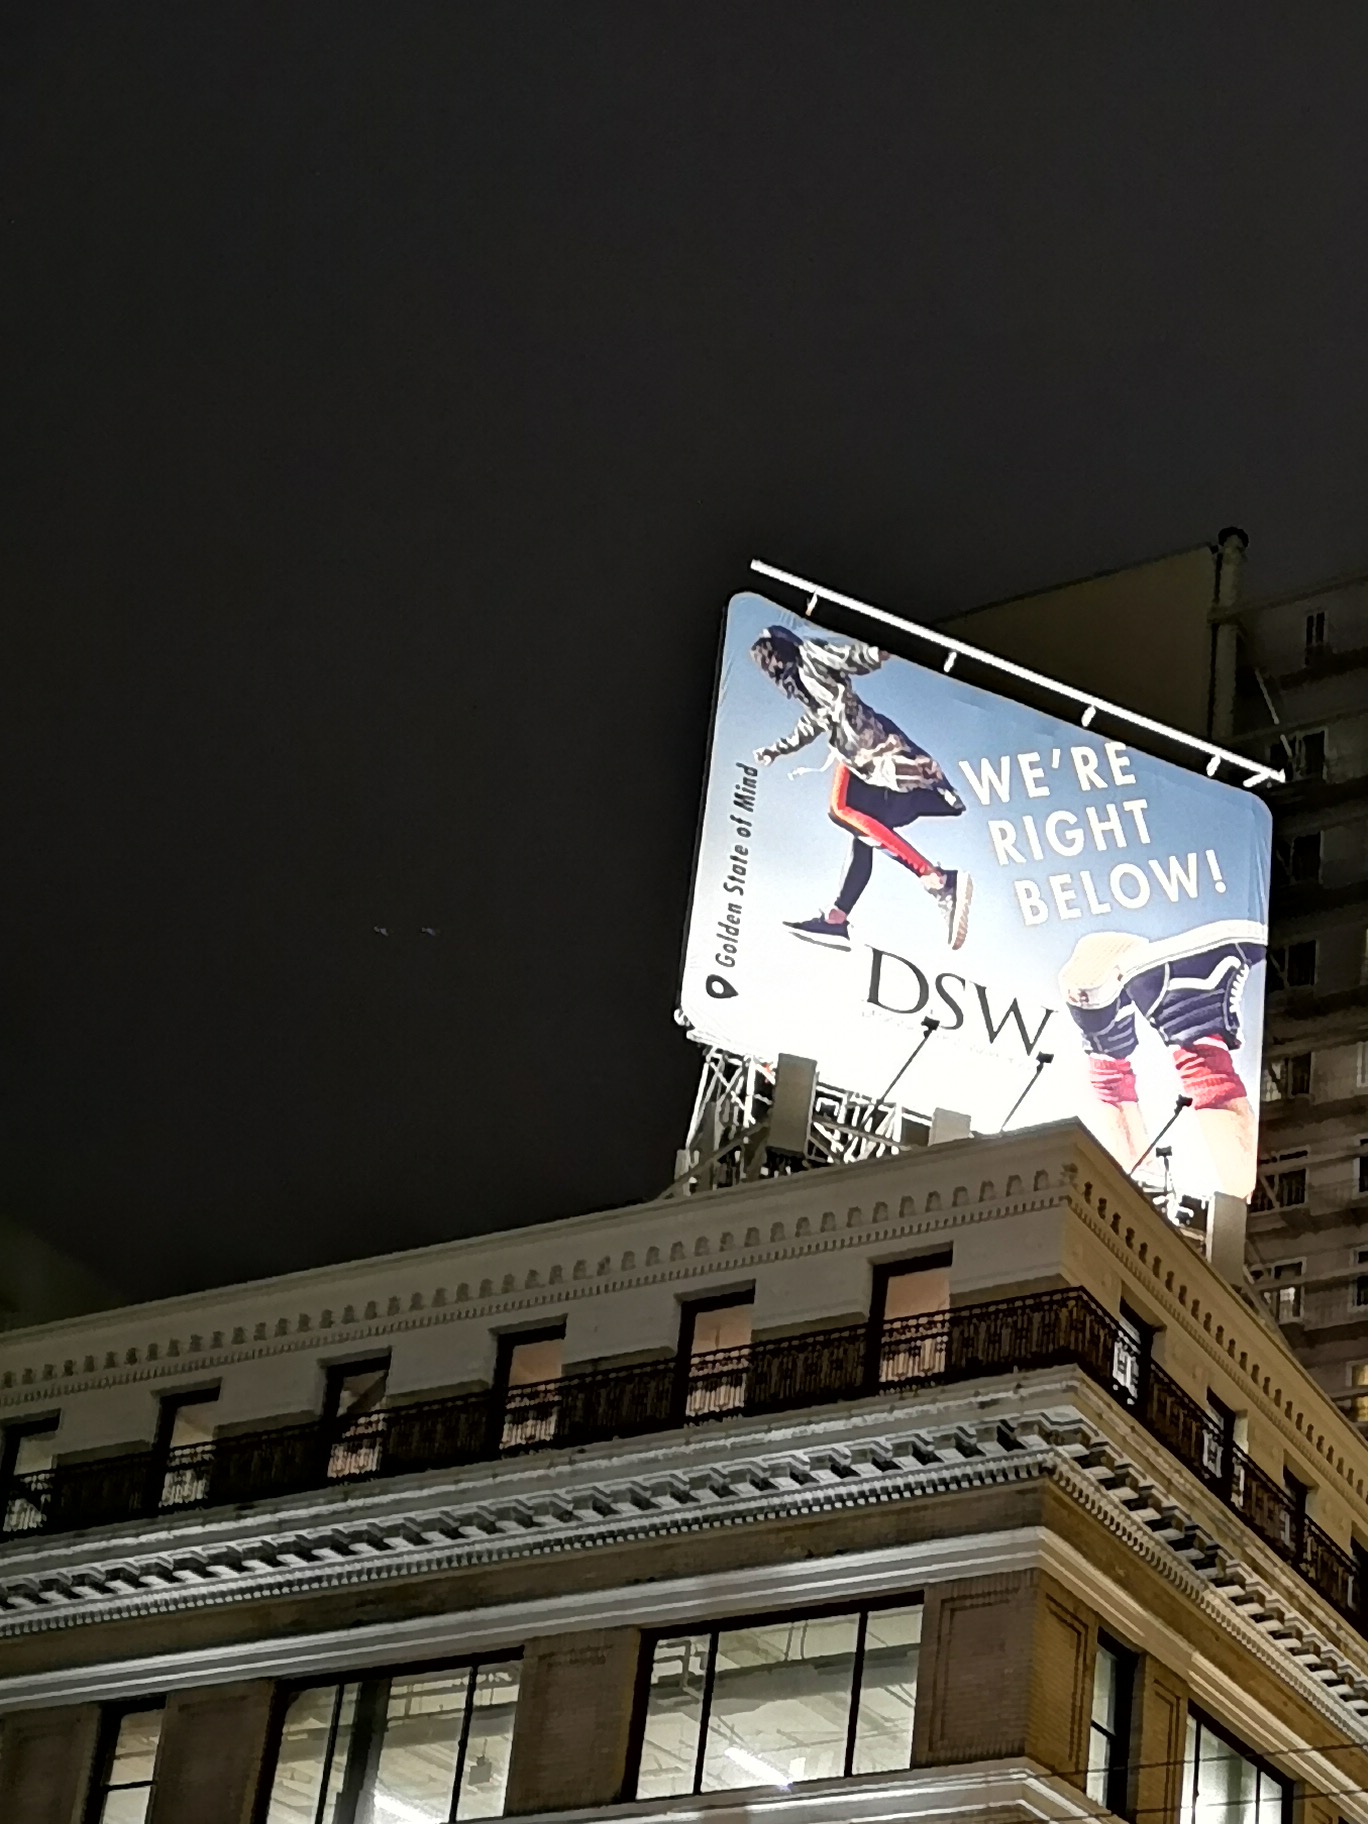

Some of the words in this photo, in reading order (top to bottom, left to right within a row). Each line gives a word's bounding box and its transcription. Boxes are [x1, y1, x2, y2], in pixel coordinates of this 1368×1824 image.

[733, 762, 758, 813] Mind
[959, 741, 1136, 805] WE'RE
[729, 814, 752, 838] of
[988, 799, 1150, 866] RIGHT
[723, 845, 749, 896] State
[1014, 849, 1226, 925] BELOW!
[715, 902, 742, 968] Golden
[864, 943, 1058, 1056] DSW
